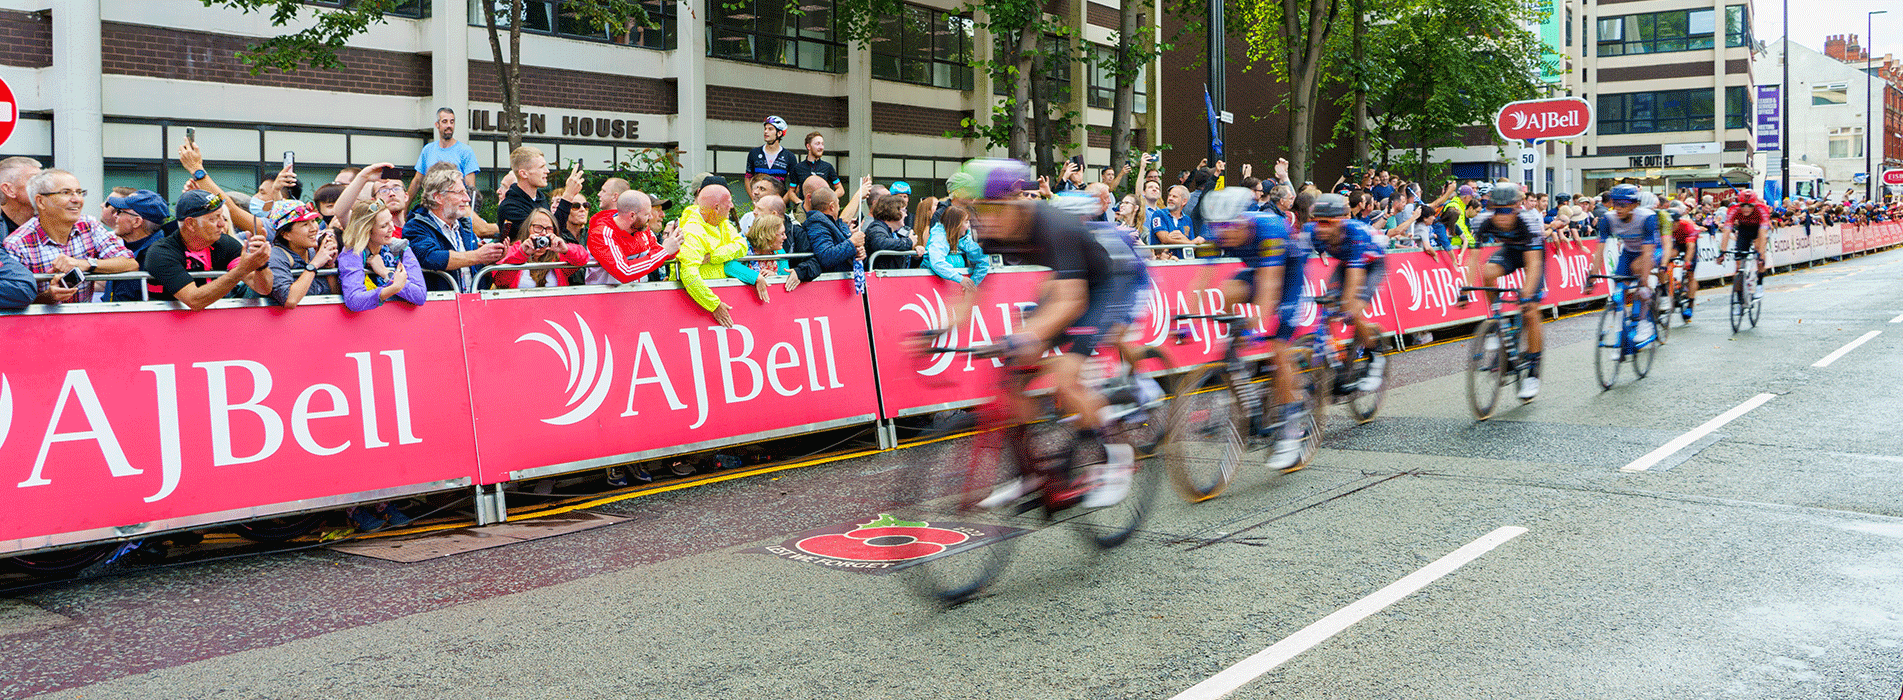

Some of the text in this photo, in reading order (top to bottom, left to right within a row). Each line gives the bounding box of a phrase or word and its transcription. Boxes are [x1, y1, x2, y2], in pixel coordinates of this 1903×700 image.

[469, 109, 639, 140] ILDEN HOUSE
[1526, 110, 1579, 132] AJBell
[1522, 153, 1535, 164] 50
[1628, 156, 1643, 167] THE
[620, 315, 845, 430] AJBell
[17, 348, 423, 503] AJBell
[765, 545, 896, 569] LEST WE FORGET
